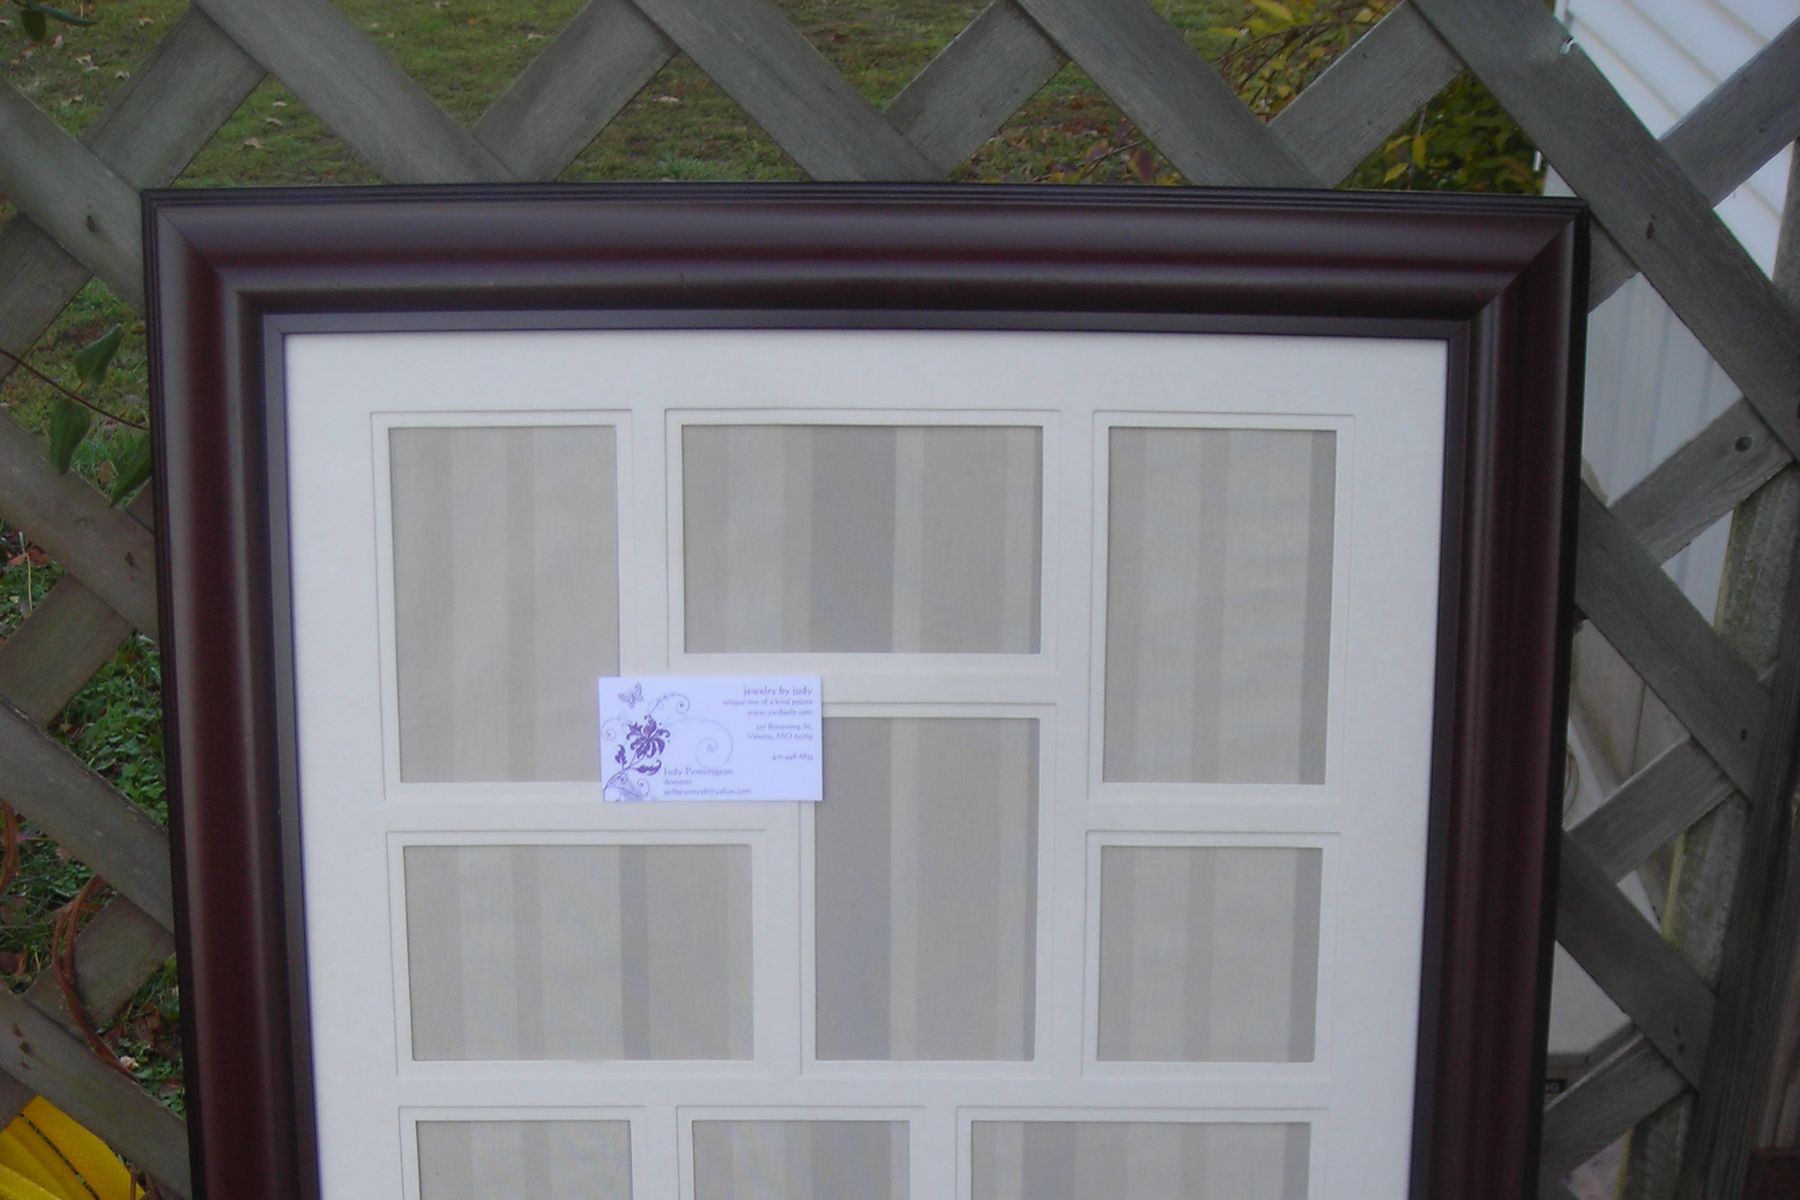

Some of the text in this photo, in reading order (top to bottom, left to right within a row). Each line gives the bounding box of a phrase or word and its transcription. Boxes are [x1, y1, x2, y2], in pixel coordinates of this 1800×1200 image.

[744, 685, 813, 697] jewelry by judy
[664, 767, 682, 777] Judy
